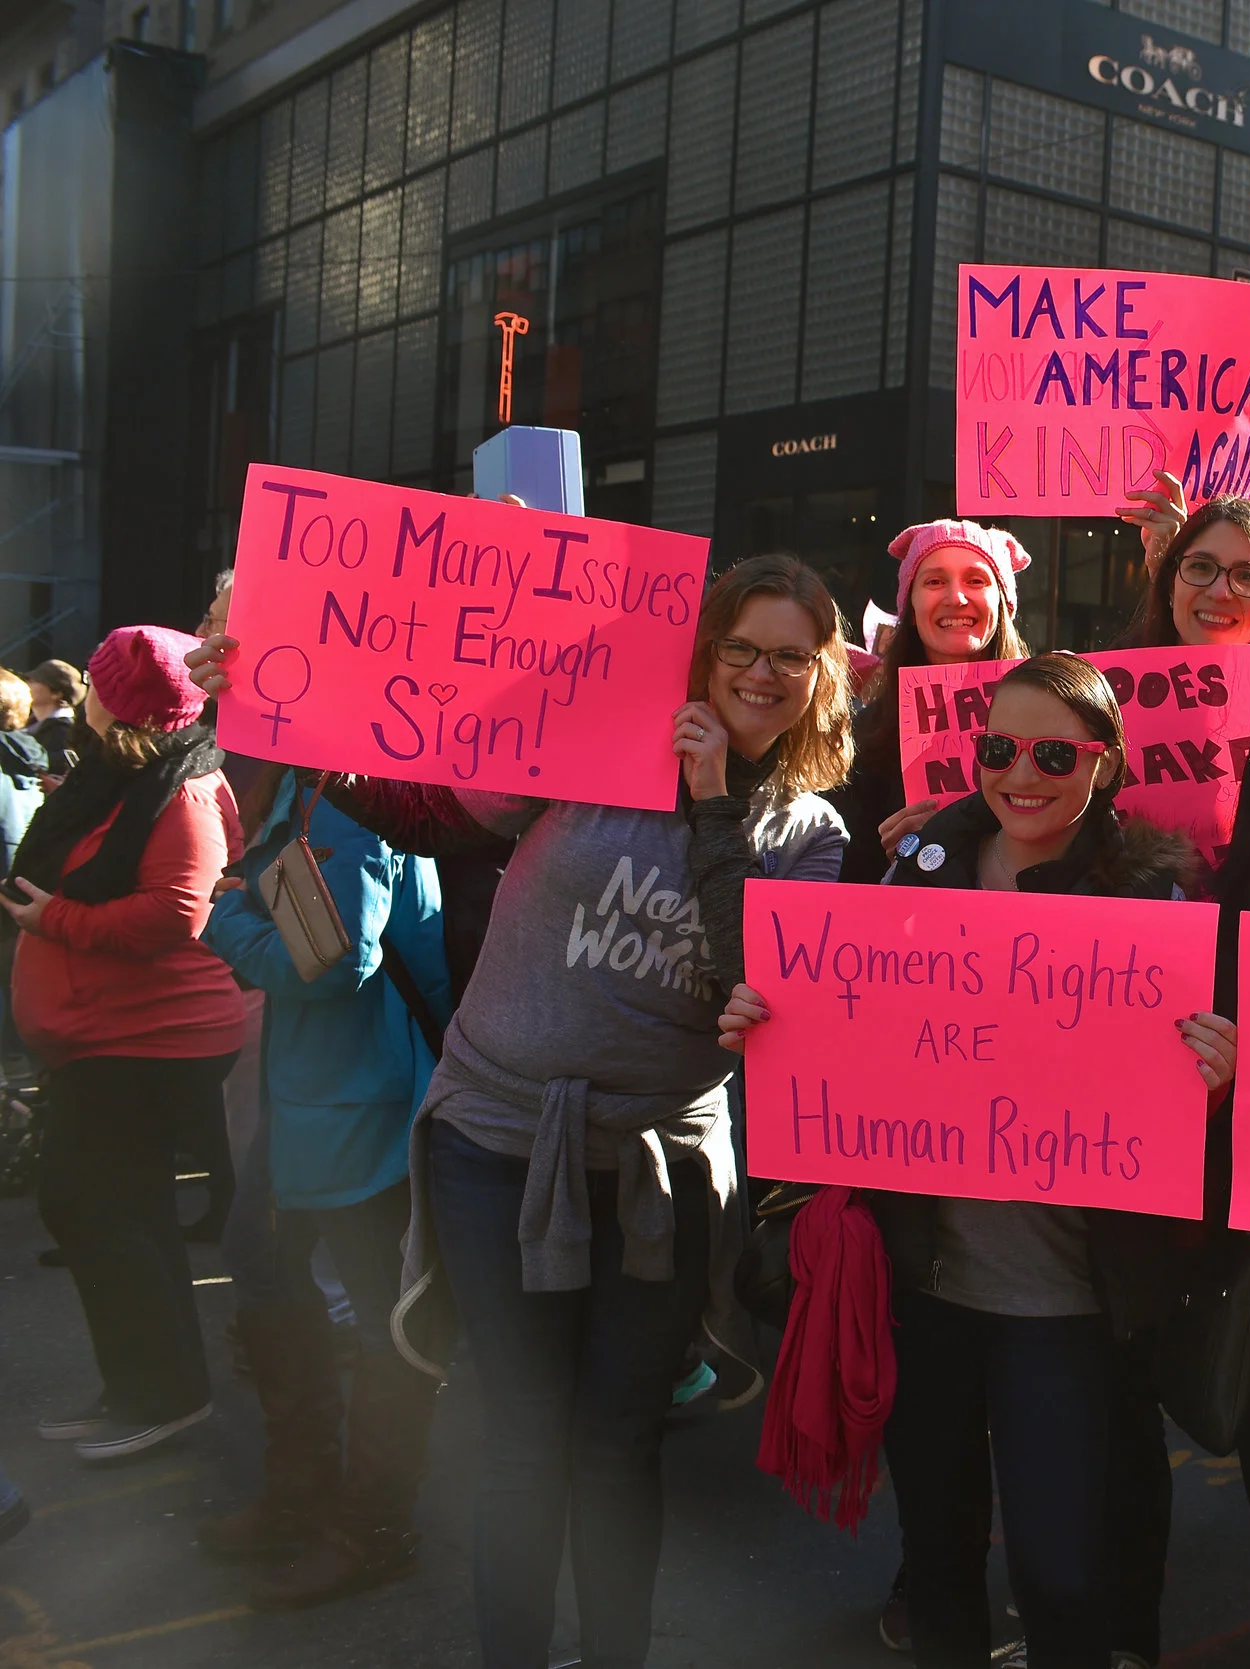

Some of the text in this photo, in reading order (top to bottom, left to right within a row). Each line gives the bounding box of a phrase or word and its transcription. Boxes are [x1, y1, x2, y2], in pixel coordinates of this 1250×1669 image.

[1087, 54, 1244, 127] COACH
[968, 274, 1148, 339] MAKE
[772, 434, 837, 457] COACH
[976, 421, 1167, 498] KIND
[262, 481, 696, 630] Too Many Issues
[319, 590, 612, 706] Not Enough
[371, 674, 549, 780] Sign!
[914, 661, 1229, 734] HA DOES
[596, 855, 709, 938] Nas
[771, 910, 1164, 1030] Women's Rights
[914, 1018, 999, 1063] ARE
[790, 1075, 1143, 1192] Human Rights
